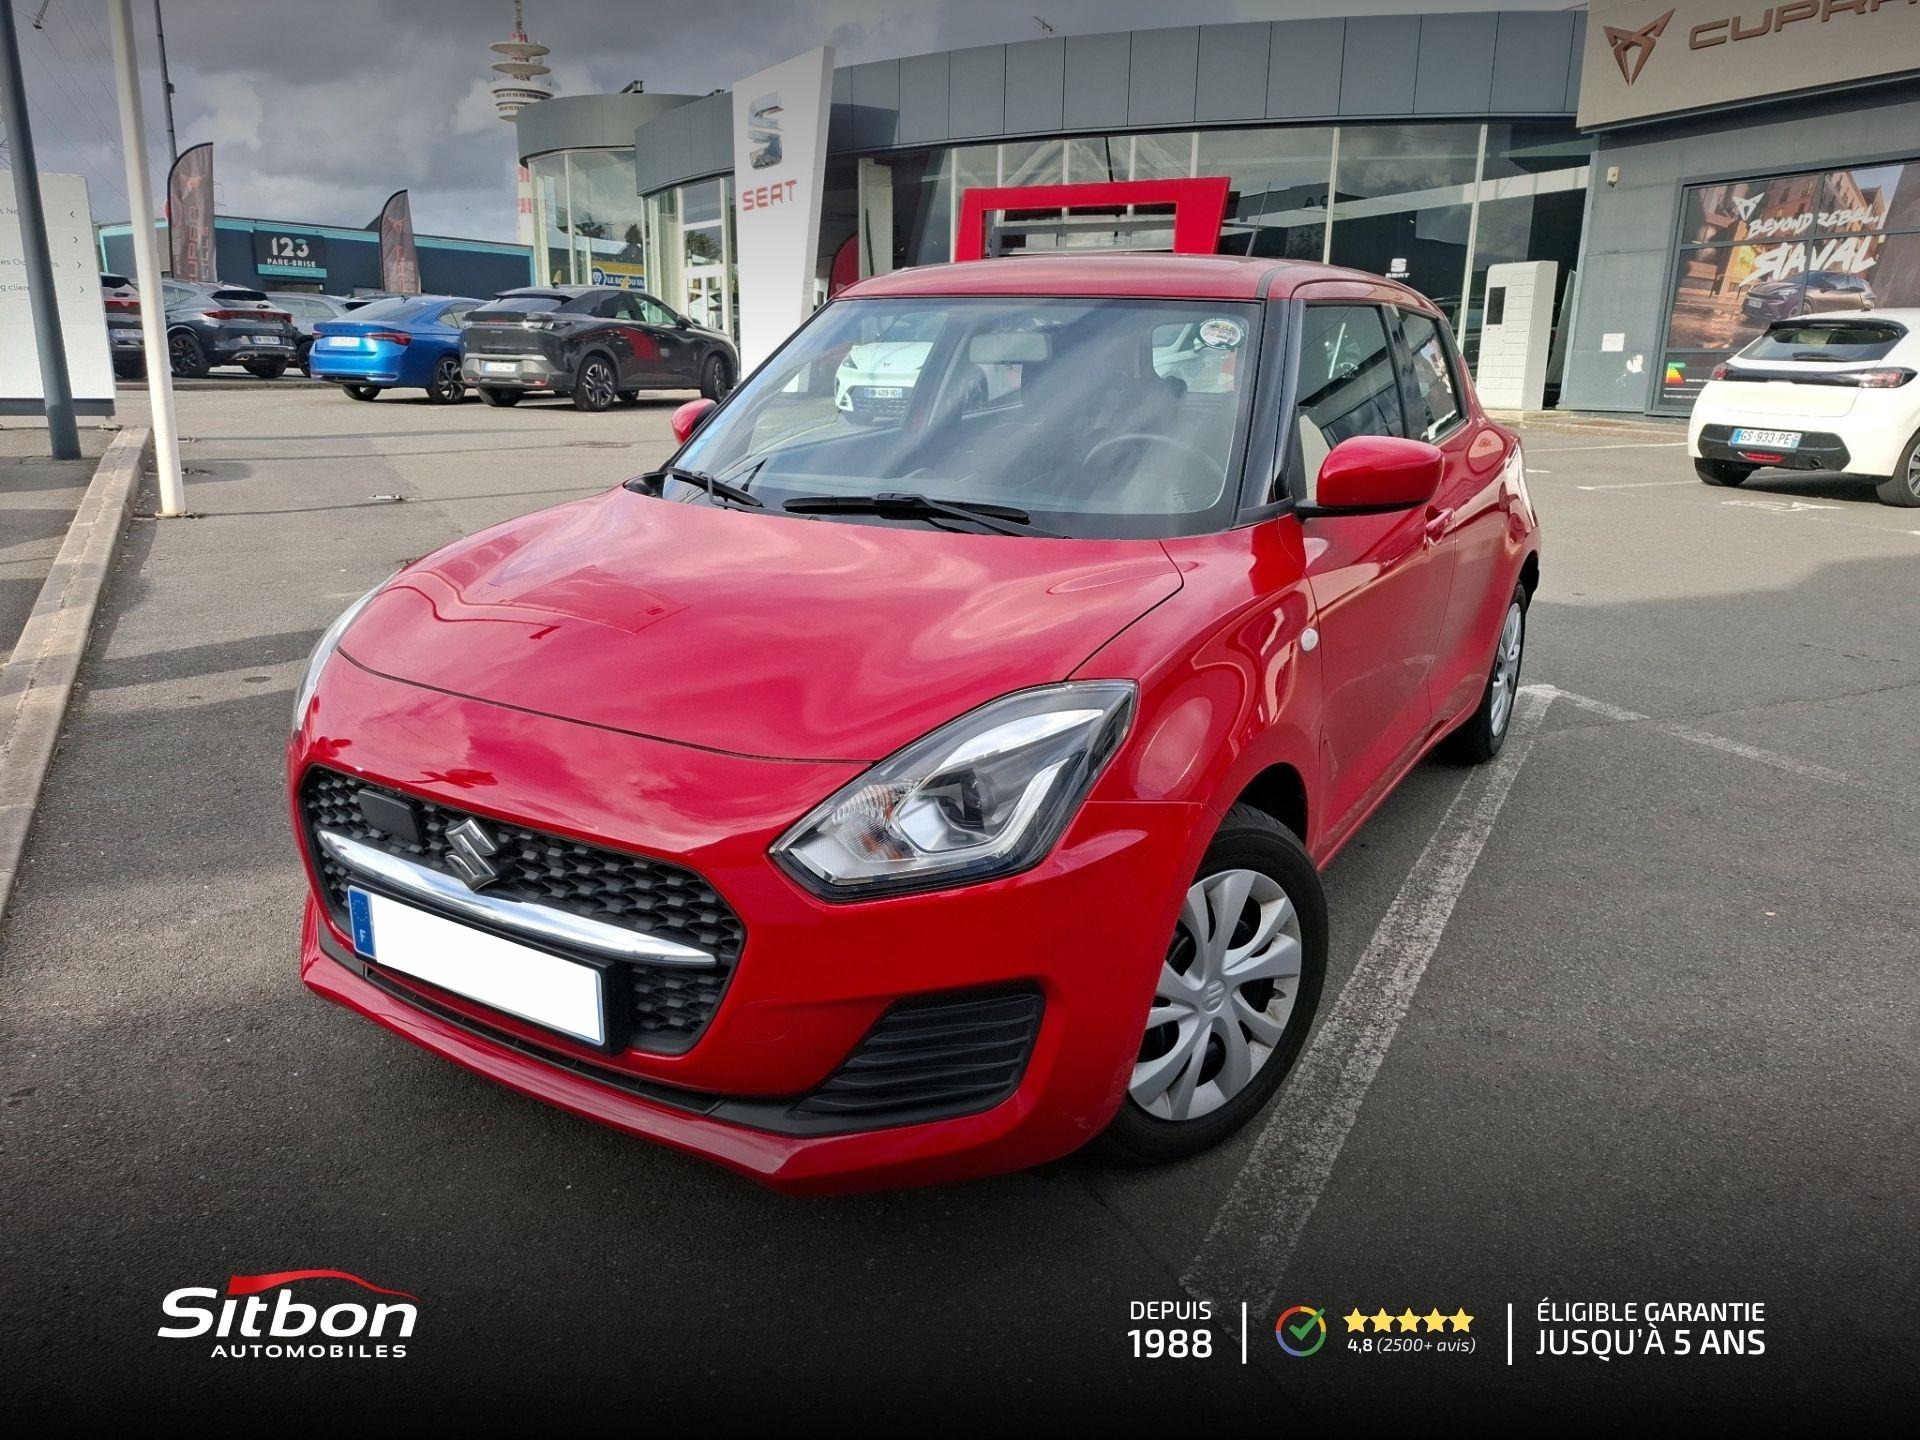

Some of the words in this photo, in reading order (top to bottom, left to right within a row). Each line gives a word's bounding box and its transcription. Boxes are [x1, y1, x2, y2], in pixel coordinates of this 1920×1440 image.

[1689, 0, 1919, 50] CUPR
[742, 180, 797, 211] SEAT
[1748, 213, 1813, 239] BEYOND
[271, 236, 309, 258] 123
[267, 257, 317, 268] PARE-BRISE
[1739, 235, 1878, 287] RAVAL
[1741, 431, 1792, 445] GS-933-PE
[359, 928, 367, 943] F
